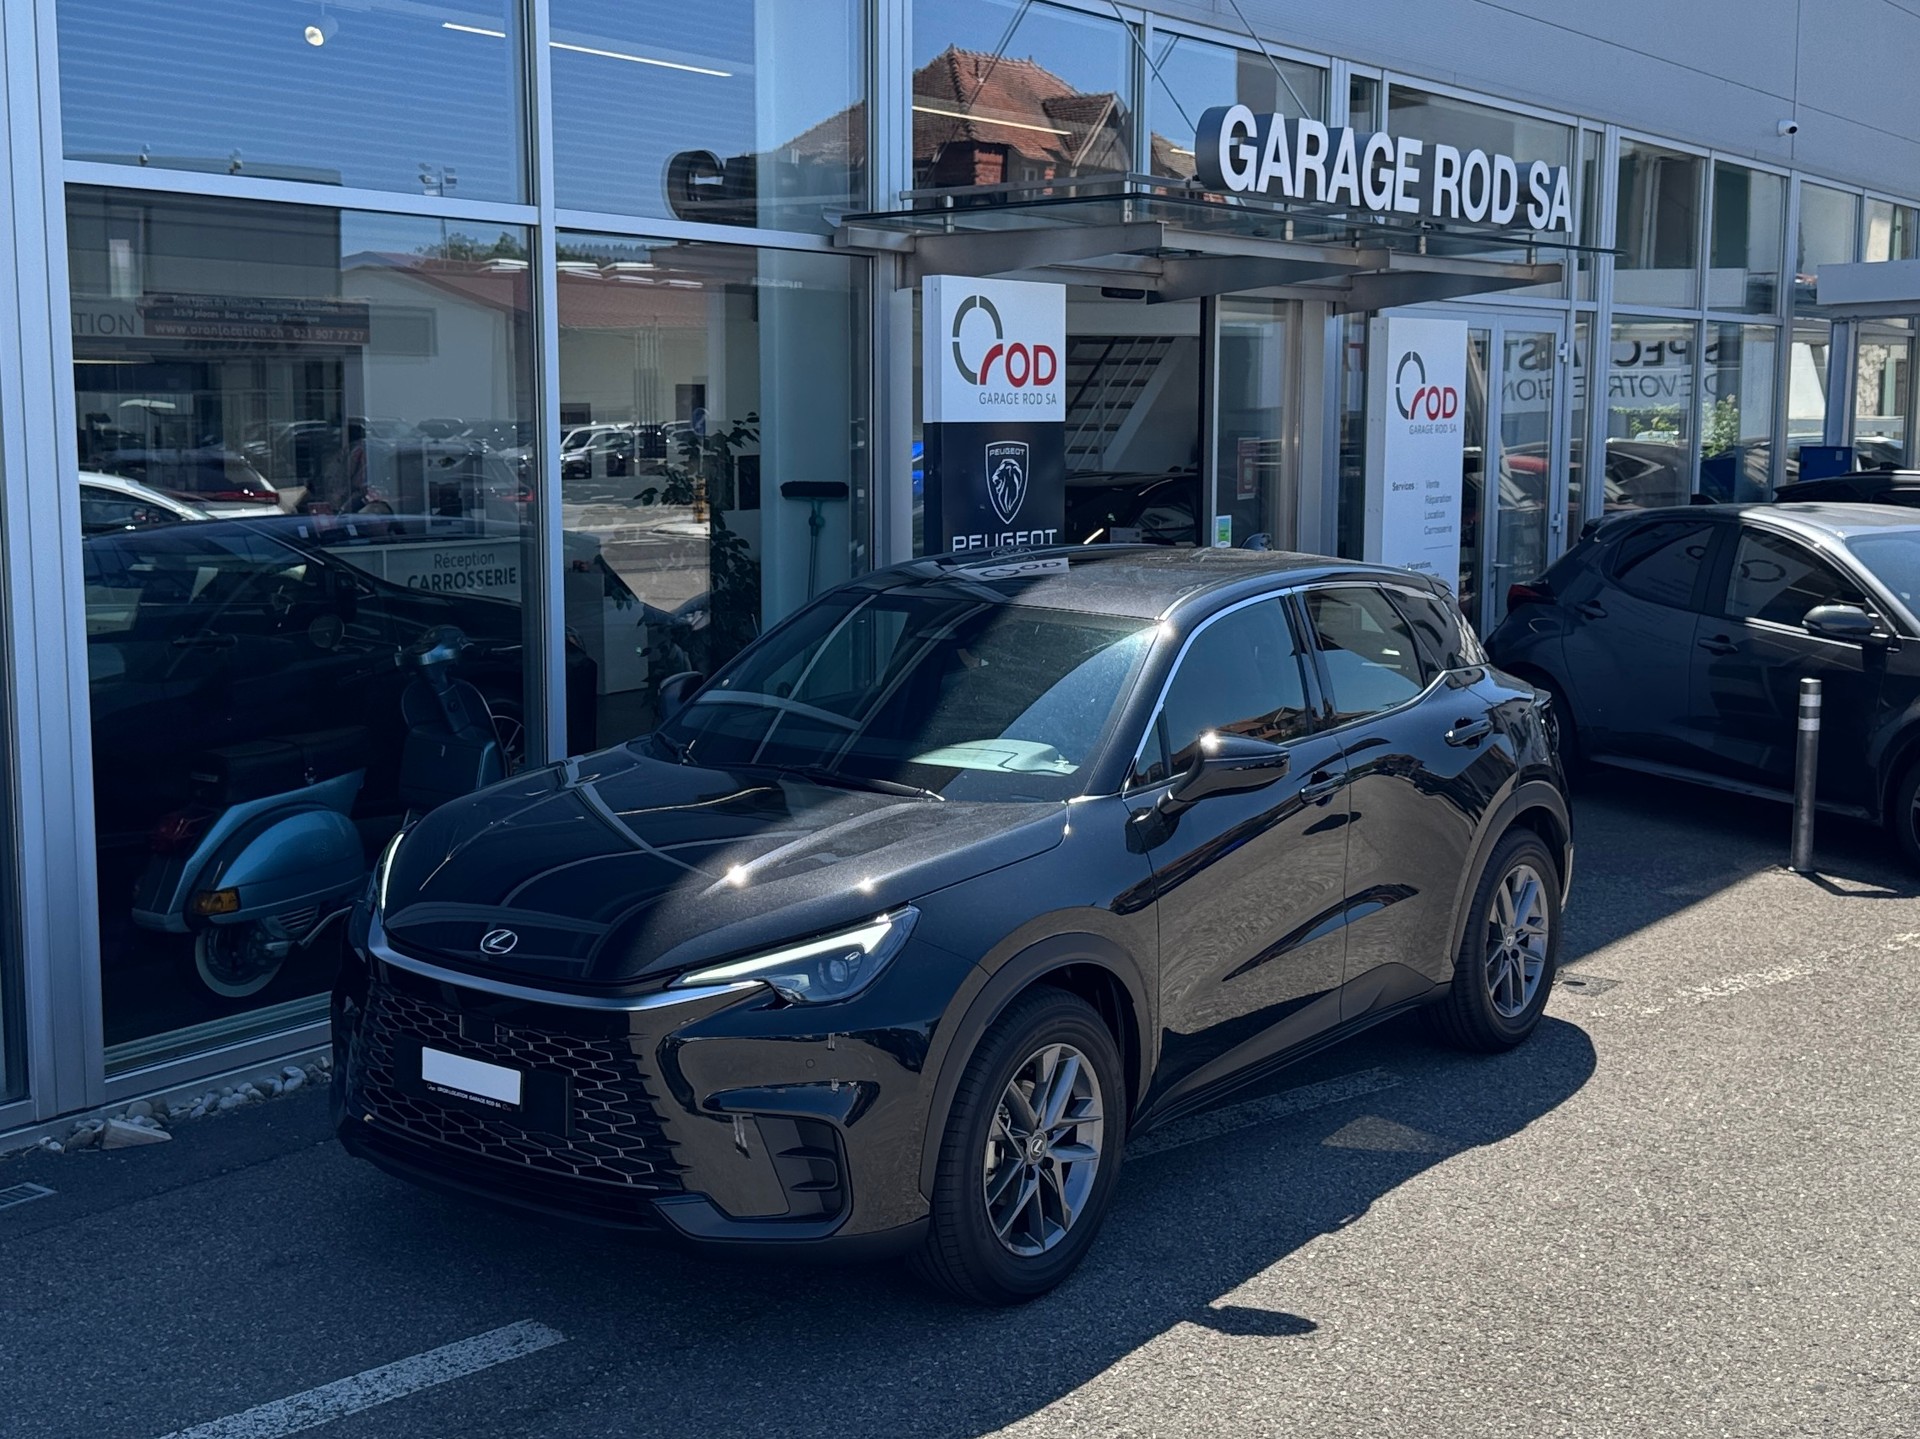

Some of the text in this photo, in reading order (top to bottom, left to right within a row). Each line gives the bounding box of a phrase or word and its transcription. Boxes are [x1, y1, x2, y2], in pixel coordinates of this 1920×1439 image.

[1219, 104, 1573, 233] GARAGE ROD SA
[978, 392, 1057, 405] GARAGE ROD SA
[1409, 423, 1457, 435] GARAGE ROD SA
[989, 447, 1026, 457] PEUGEOT
[1392, 480, 1440, 491] Services Vente
[1424, 510, 1446, 520] Location
[952, 529, 1058, 552] PEUGEOT
[433, 551, 495, 570] Réception
[407, 567, 517, 591] CARROSSERIE
